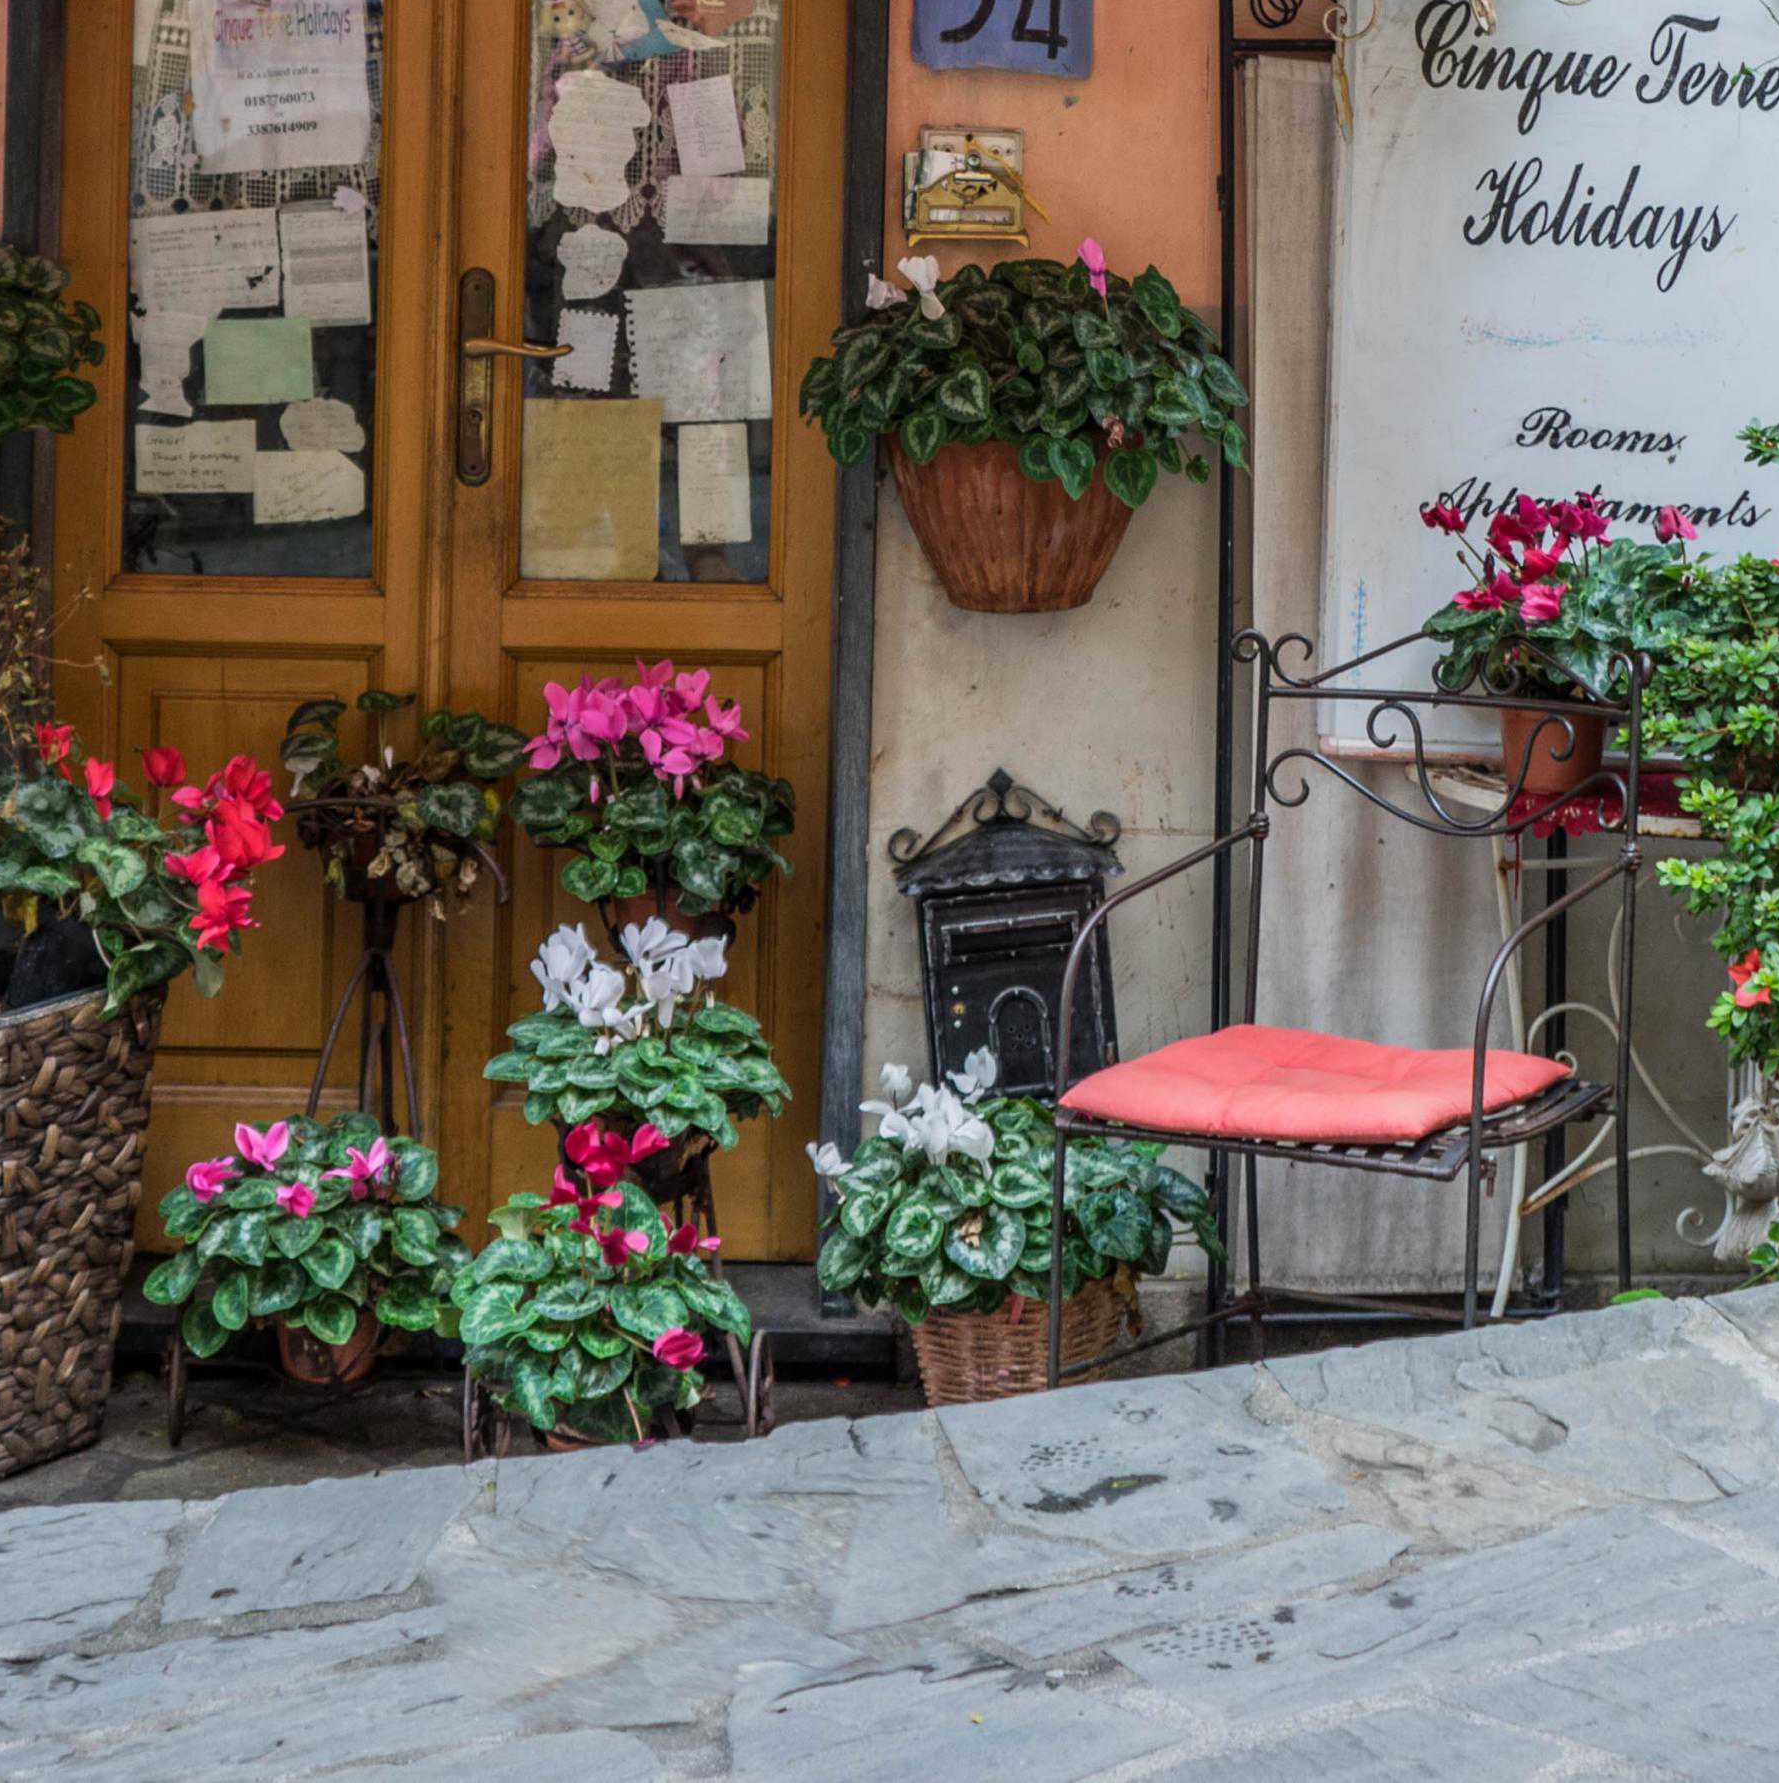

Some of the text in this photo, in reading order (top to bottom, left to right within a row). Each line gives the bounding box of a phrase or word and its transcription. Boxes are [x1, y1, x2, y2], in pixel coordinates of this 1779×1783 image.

[1463, 158, 1738, 293] Holidays
[1516, 406, 1687, 453] Rooms
[1419, 476, 1772, 534] Apptaments
